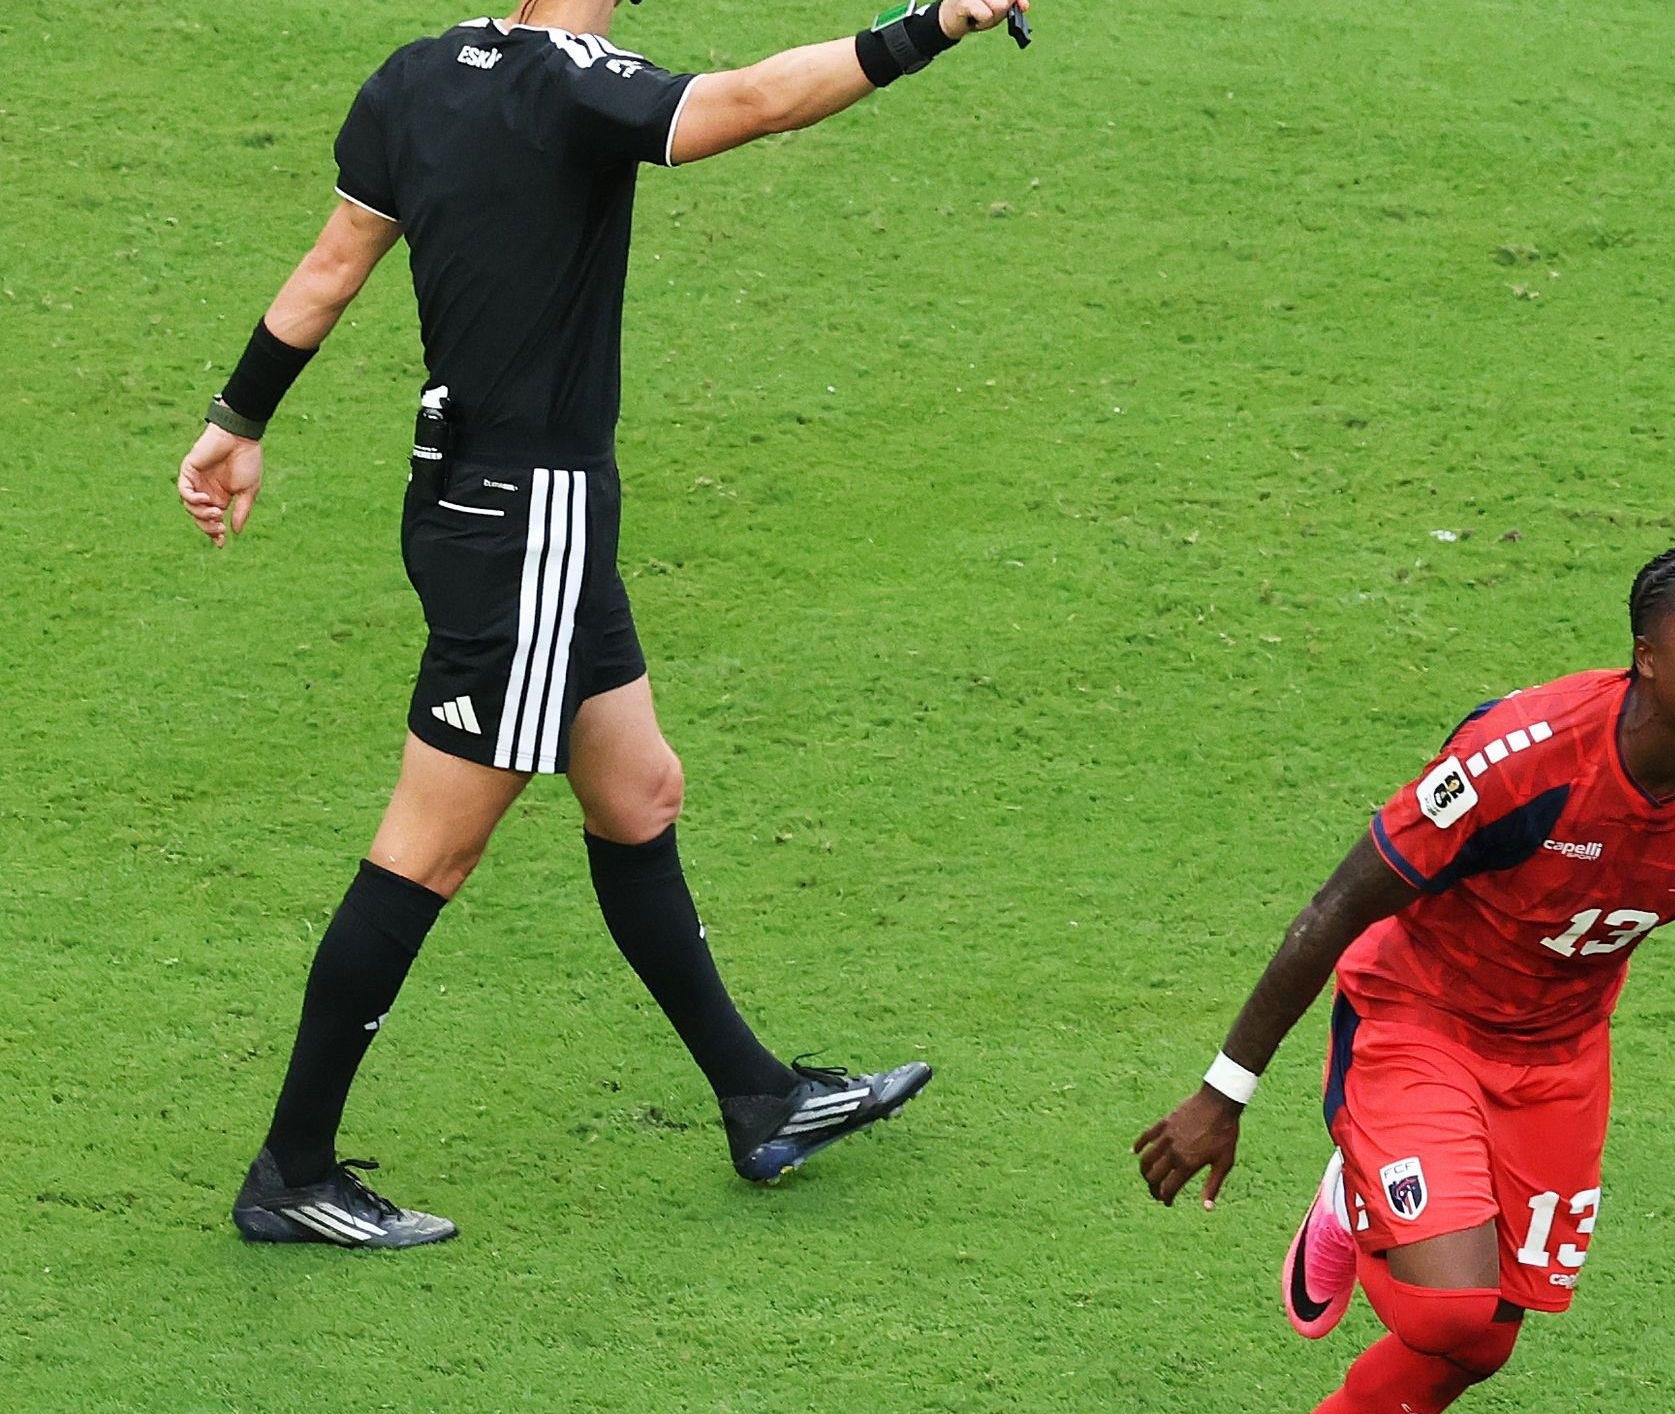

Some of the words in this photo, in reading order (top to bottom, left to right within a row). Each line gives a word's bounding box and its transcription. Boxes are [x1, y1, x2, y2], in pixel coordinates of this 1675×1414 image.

[1543, 839, 1603, 857] capelli
[1540, 908, 1660, 957] 13
[1383, 1162, 1417, 1178] FCF
[1517, 1186, 1601, 1267] 13
